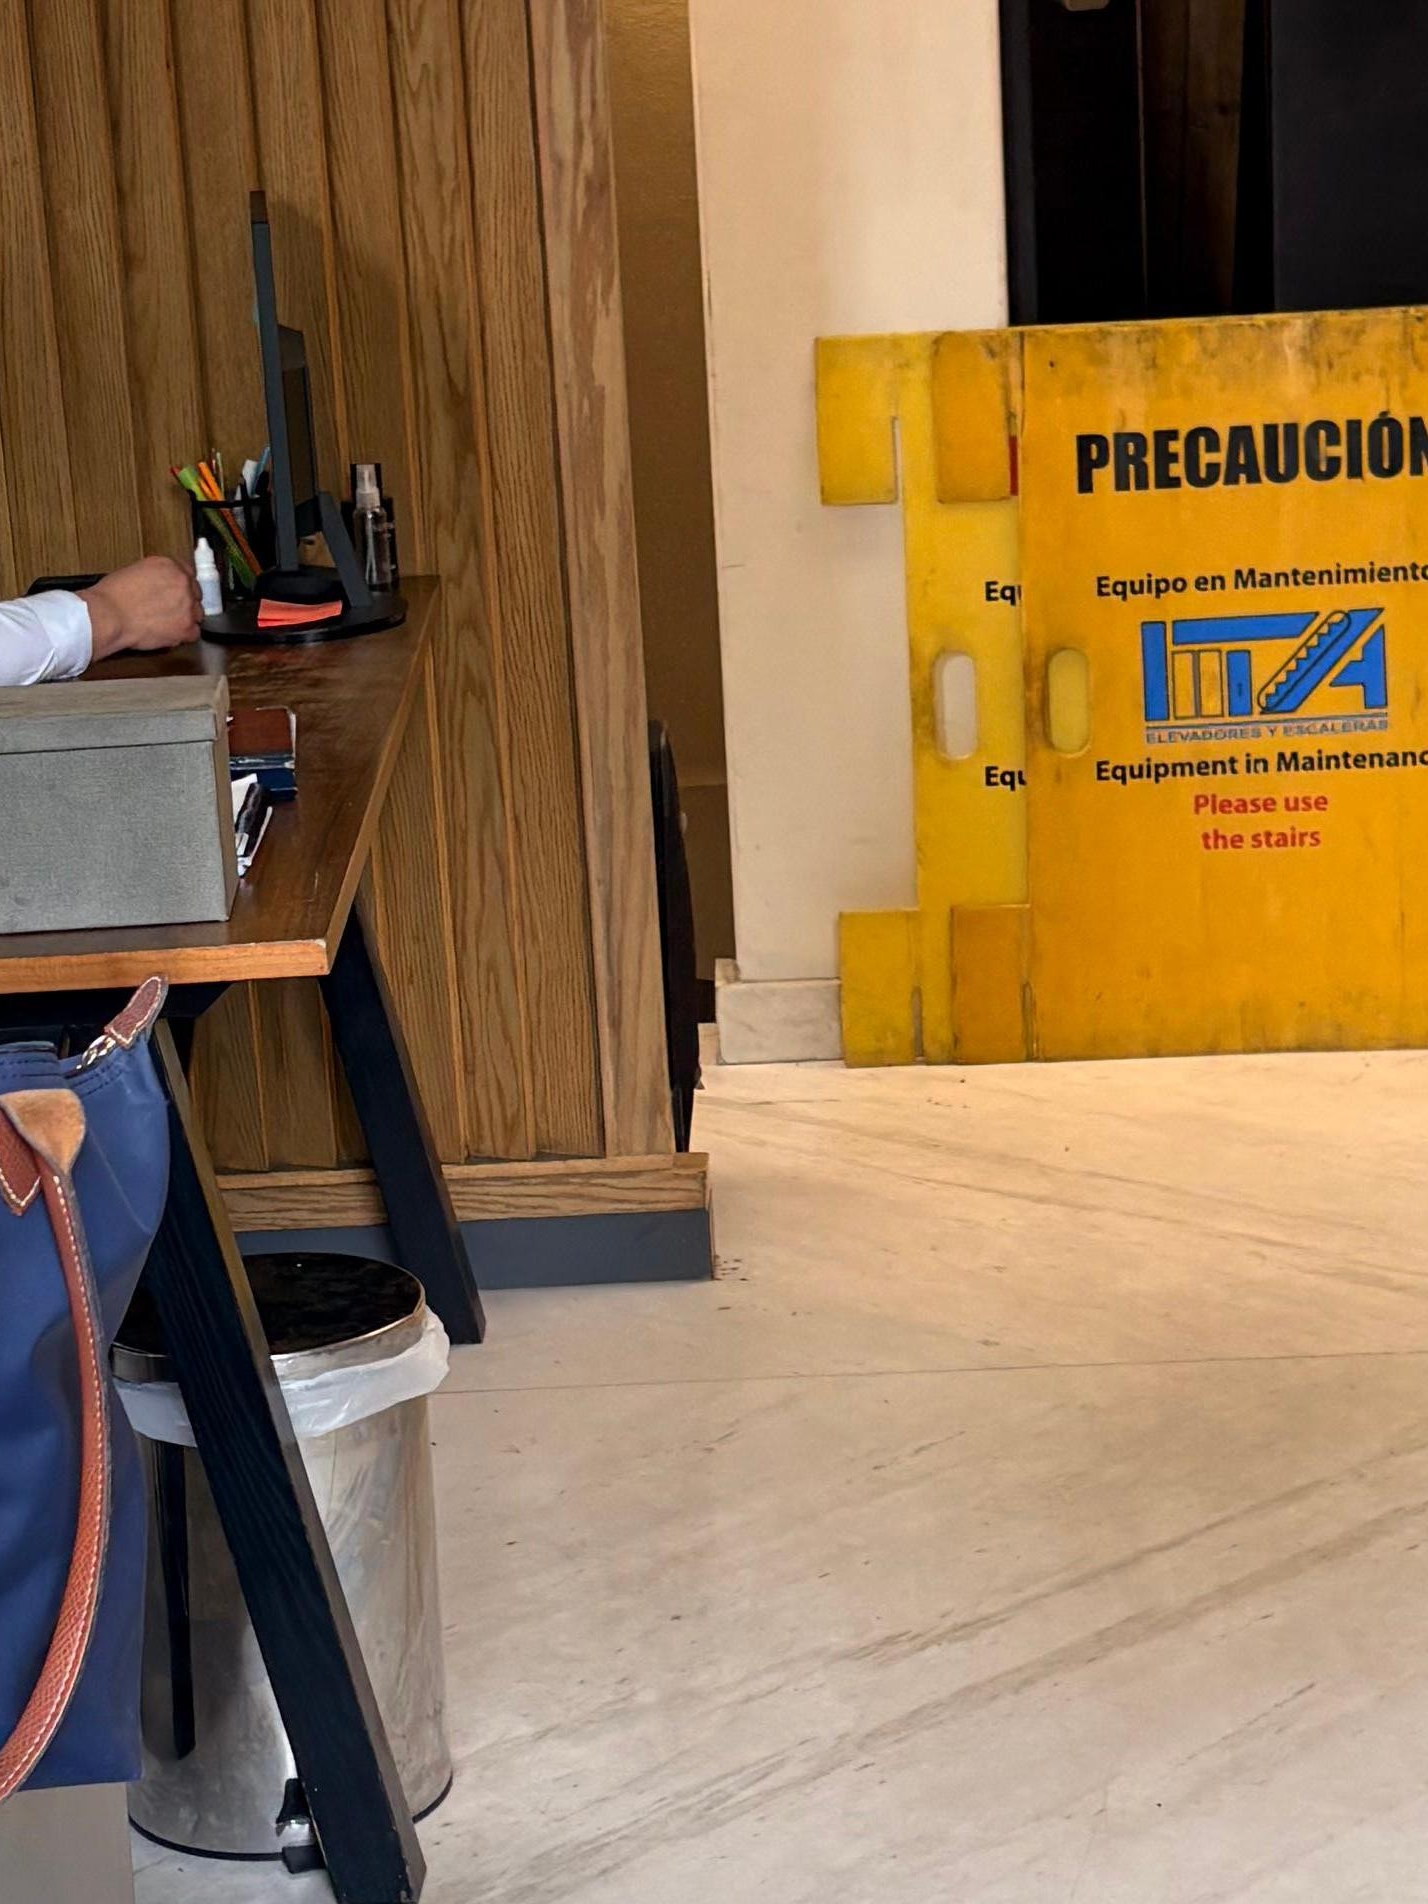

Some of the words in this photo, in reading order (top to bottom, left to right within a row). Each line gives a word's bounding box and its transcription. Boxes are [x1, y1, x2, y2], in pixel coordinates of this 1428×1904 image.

[1096, 573, 1188, 602] Equipo
[1194, 575, 1226, 592] en
[1146, 727, 1262, 745] ELEVADORES
[1263, 726, 1276, 737] Y
[1283, 719, 1389, 738] ESCALERAS
[1096, 756, 1238, 784] Equipment
[1245, 753, 1269, 774] in
[1194, 793, 1277, 815] Please
[1284, 795, 1329, 812] use
[1201, 828, 1245, 850] the
[1251, 826, 1321, 849] stairs
